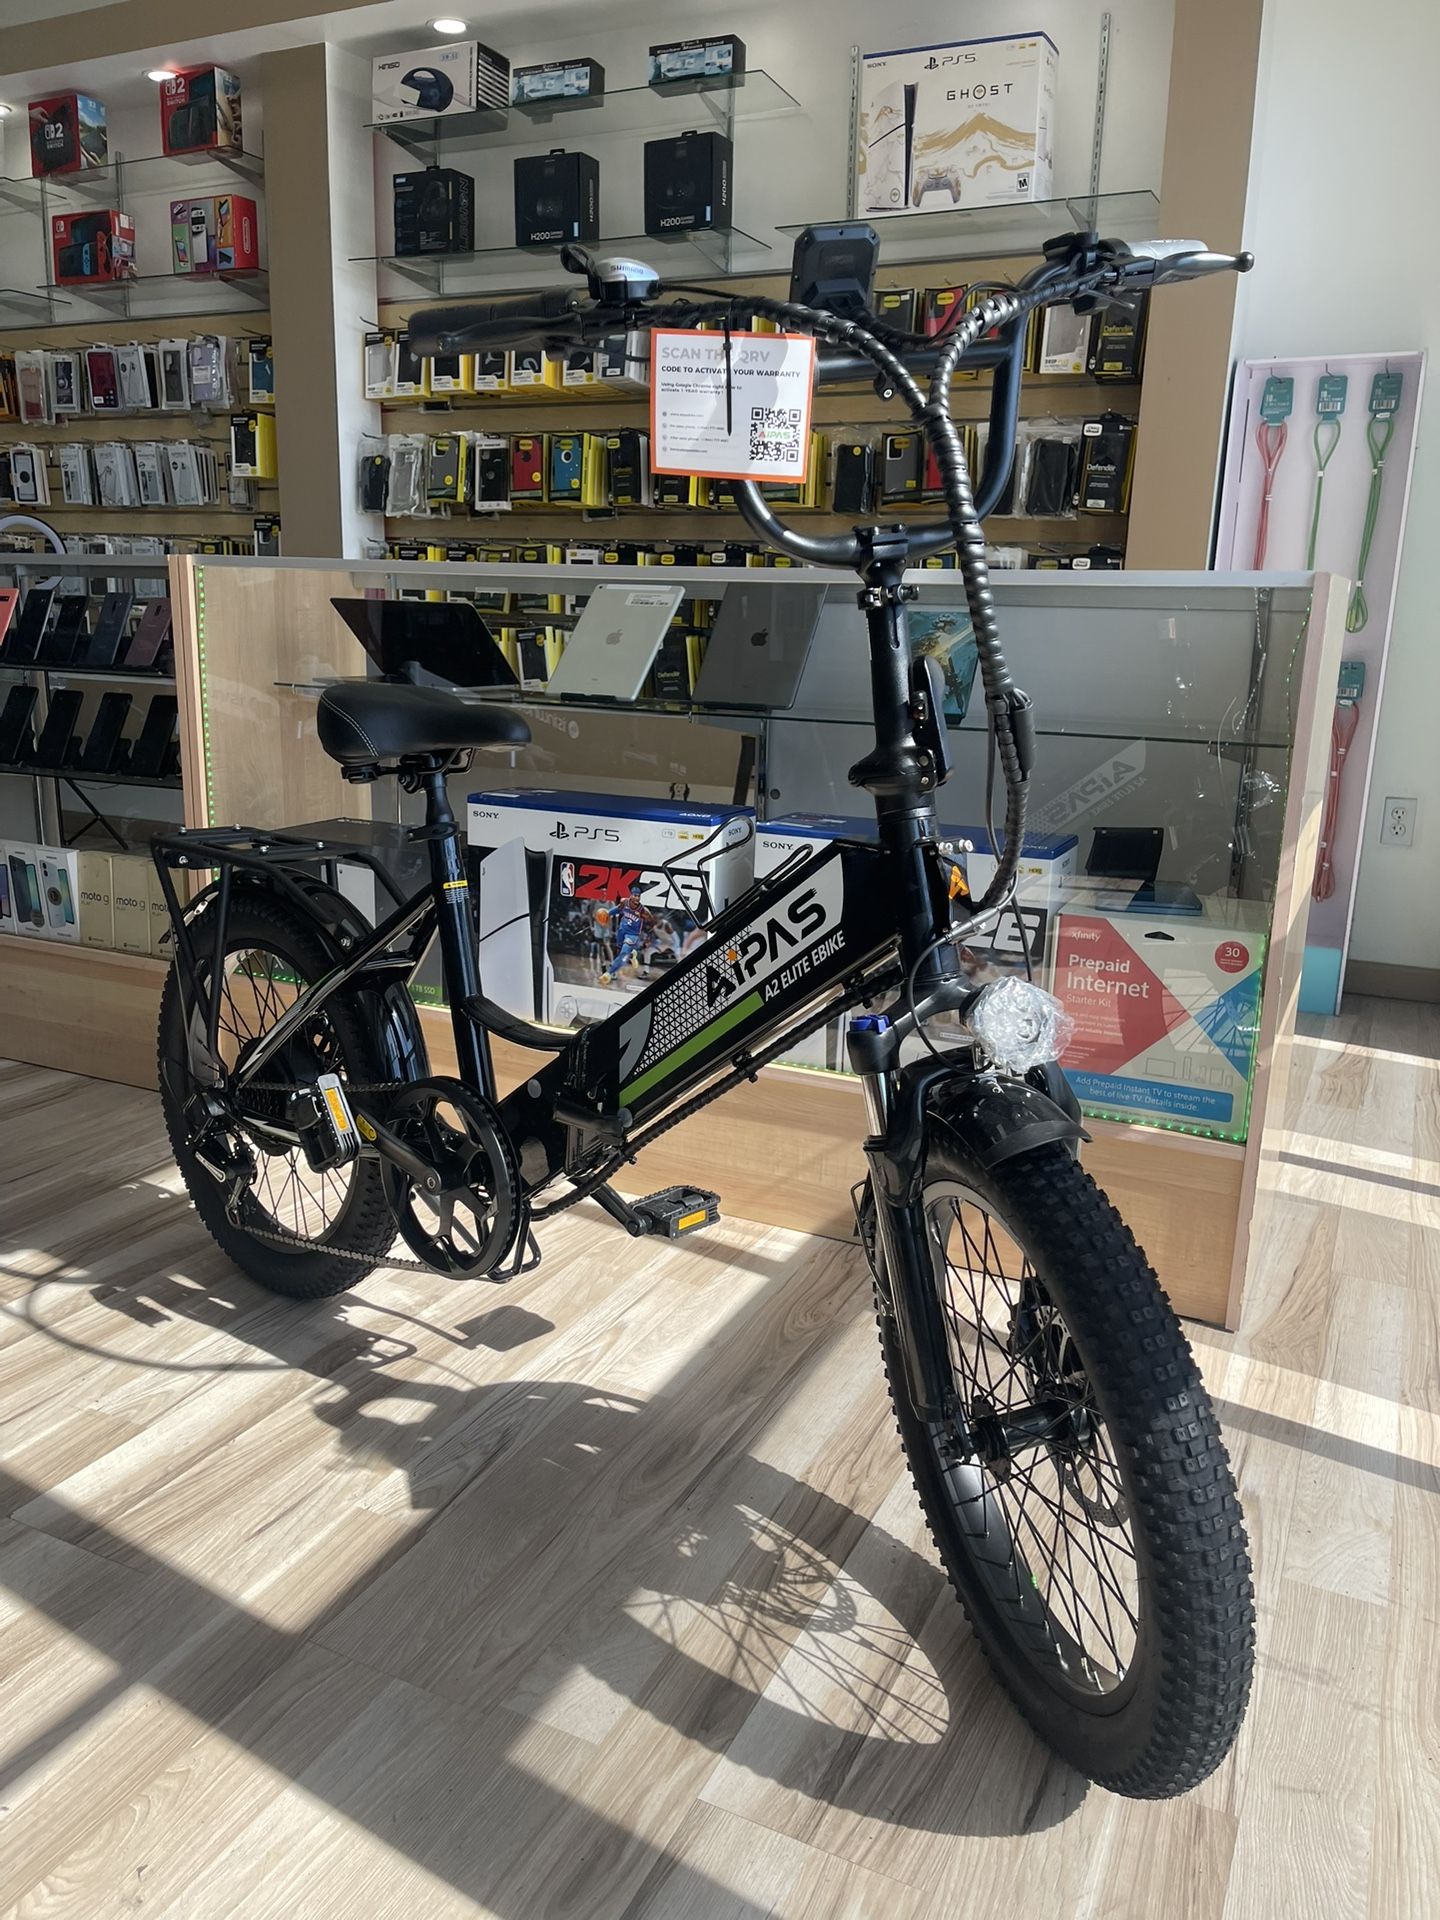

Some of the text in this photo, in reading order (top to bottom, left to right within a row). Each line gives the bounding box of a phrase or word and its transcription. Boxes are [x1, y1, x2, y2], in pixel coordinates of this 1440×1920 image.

[867, 61, 887, 69] SONY
[942, 53, 976, 66] PS5
[946, 83, 1014, 100] GHOST
[1018, 178, 1028, 189] M
[660, 217, 680, 227] H200
[530, 231, 550, 240] H200
[661, 347, 700, 359] SCAN
[738, 350, 770, 364] QRV
[683, 366, 693, 374] TO
[695, 367, 731, 375] ACTIVAT
[734, 368, 754, 376] YOUR
[756, 370, 800, 378] WARRANTY
[1086, 463, 1117, 472] Defender
[472, 810, 499, 819] SONY
[574, 826, 620, 843] PS5
[728, 827, 742, 837] SONY
[762, 840, 794, 851] SONY
[81, 891, 110, 906] moto g
[116, 897, 146, 911] moto g
[151, 902, 168, 912] mot
[1071, 930, 1101, 943] xfinity
[1225, 946, 1240, 958] 30
[765, 929, 847, 1002] A2 ELITE EBIKE
[1068, 953, 1130, 974] Prepaid
[1067, 971, 1150, 999] Internet
[1066, 993, 1112, 1008] Starter Kit
[1075, 1076, 1215, 1105] Add Prepaid Instant TV to stream the
[1089, 1087, 1199, 1111] best of live TV. Details inside.
